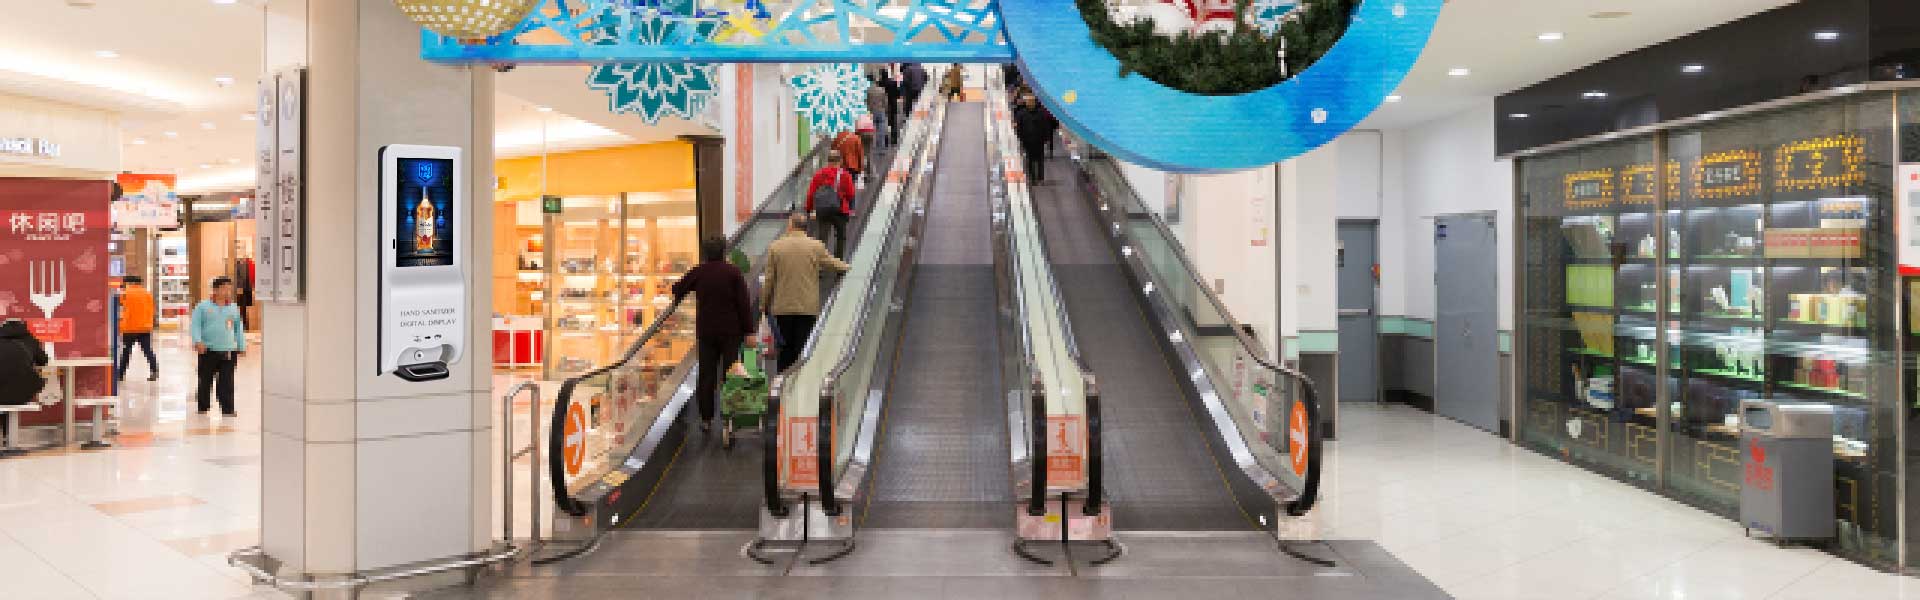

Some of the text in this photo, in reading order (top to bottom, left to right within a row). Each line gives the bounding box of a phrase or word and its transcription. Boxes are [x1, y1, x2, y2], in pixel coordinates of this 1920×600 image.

[8, 212, 86, 234] 休闲吧
[428, 318, 456, 326] DISPLAY
